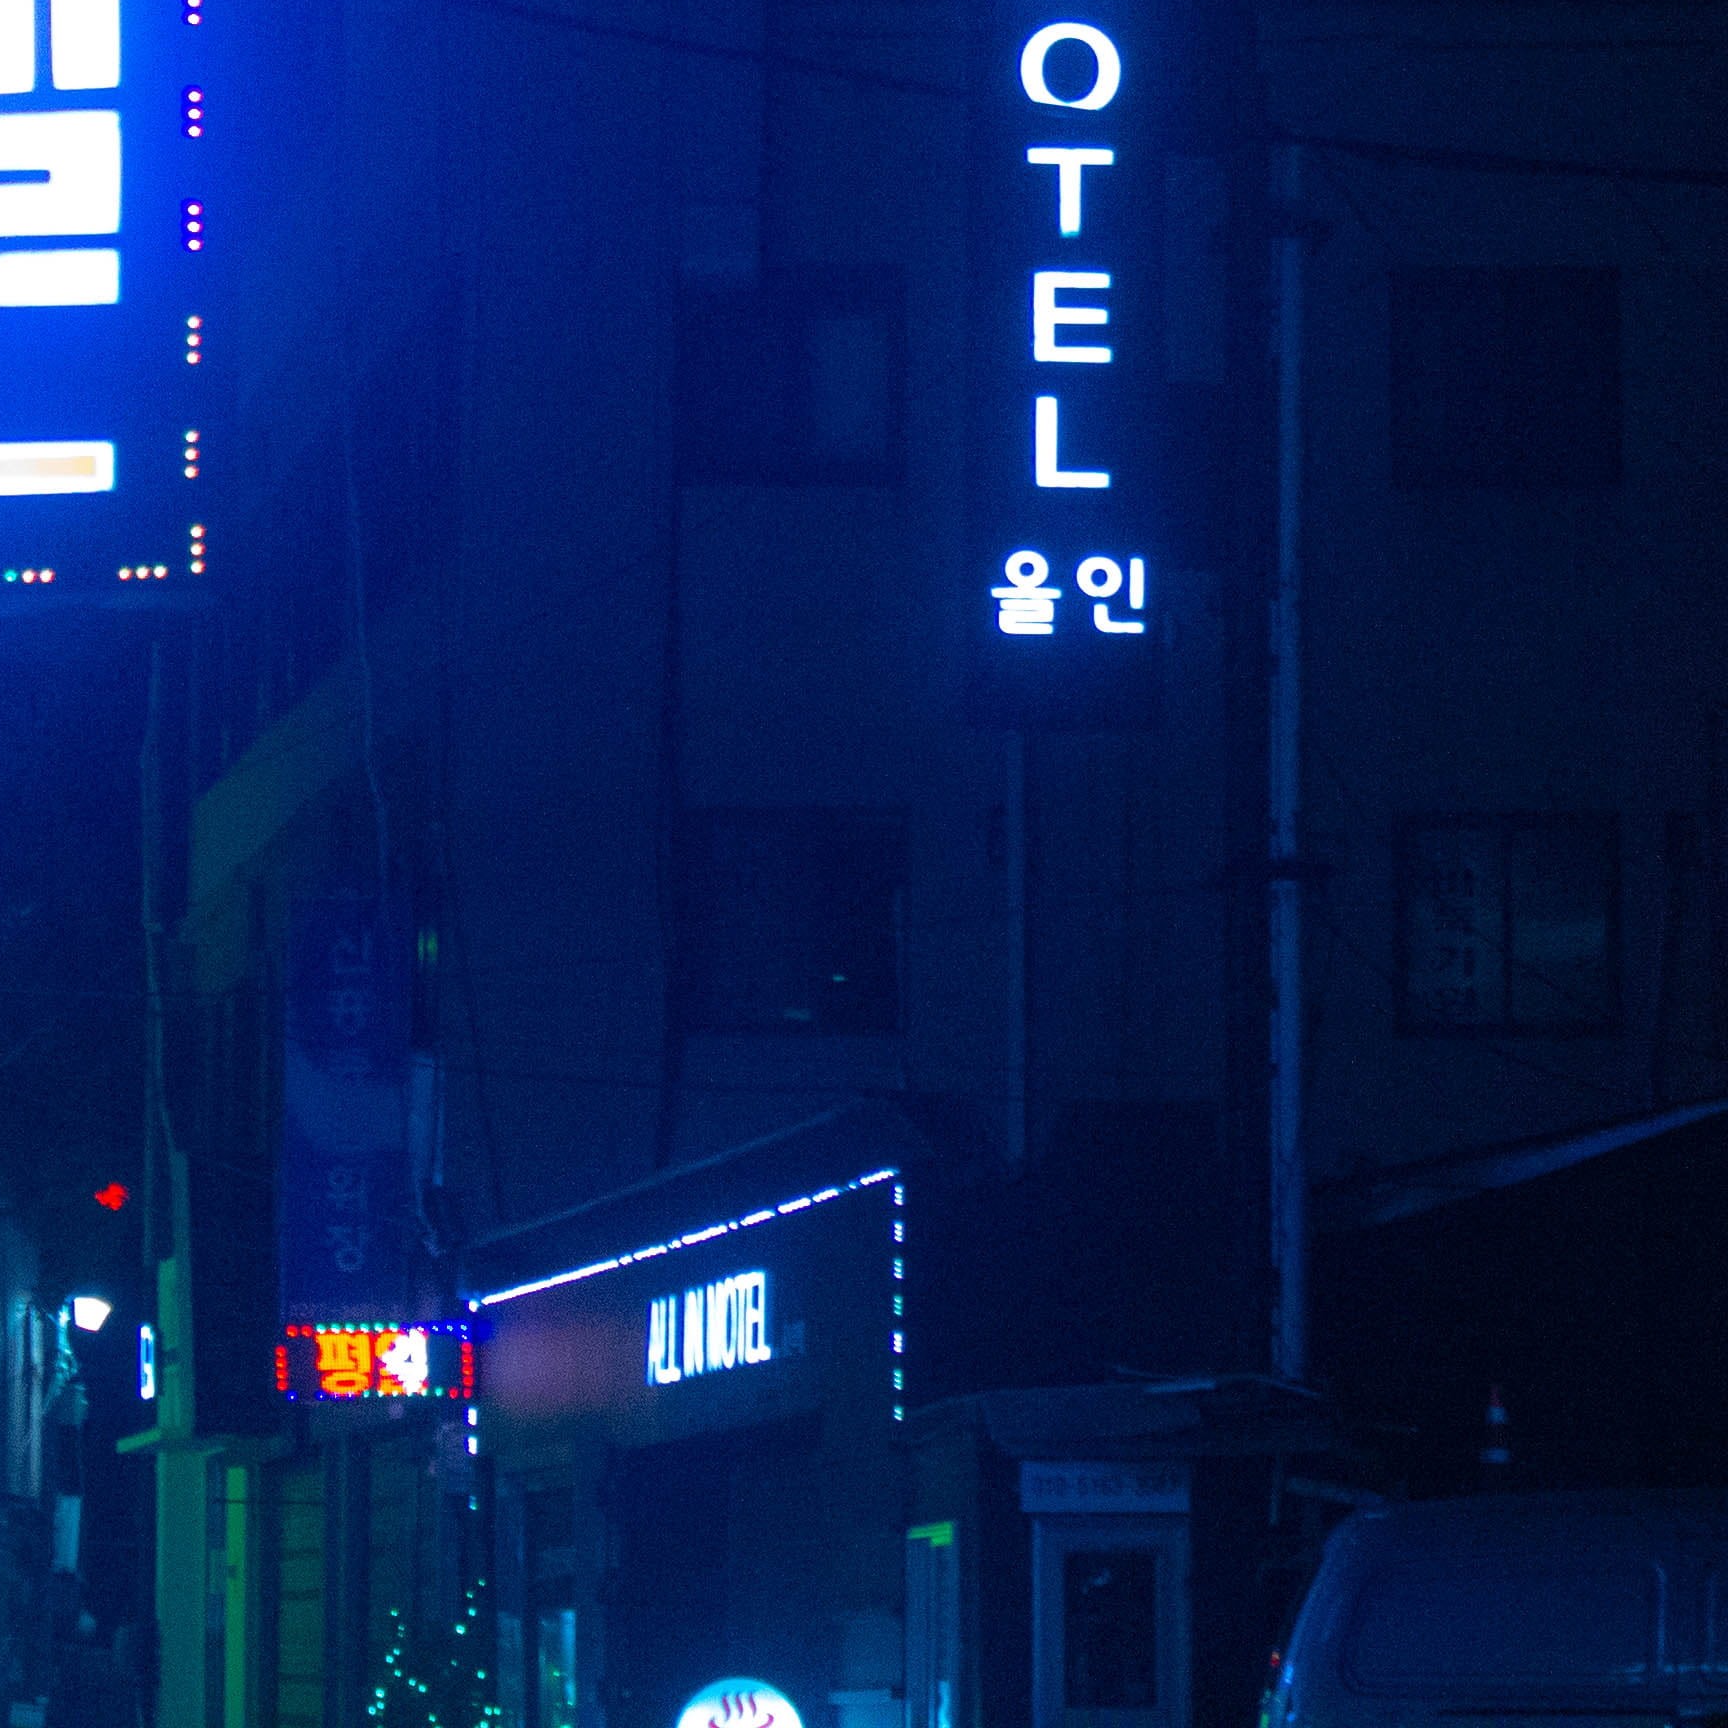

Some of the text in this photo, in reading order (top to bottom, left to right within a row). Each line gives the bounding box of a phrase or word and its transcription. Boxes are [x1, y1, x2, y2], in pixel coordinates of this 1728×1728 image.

[990, 549, 1146, 636] 올인
[646, 1270, 772, 1386] ALL IN MOTEL
